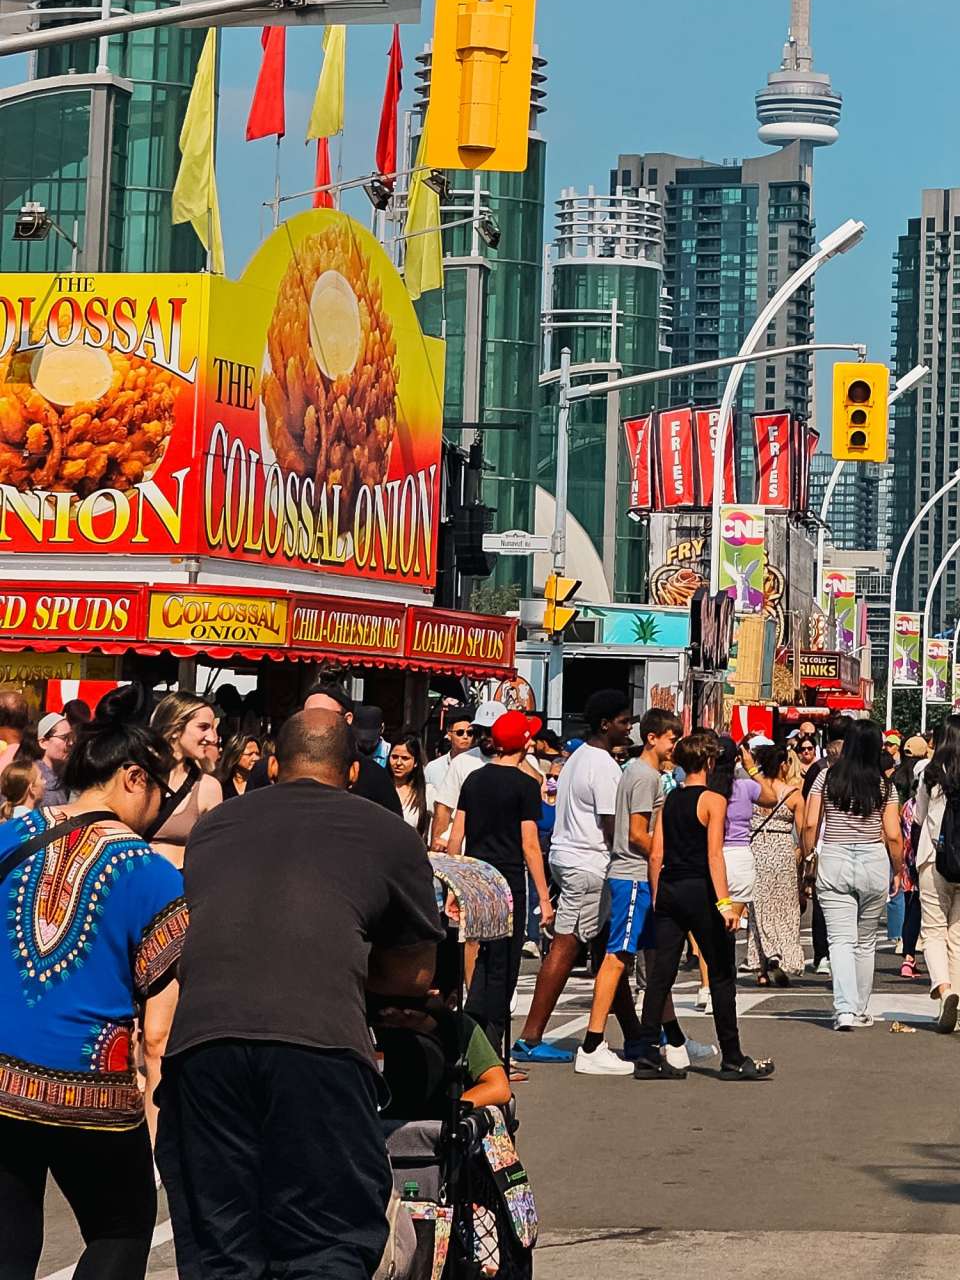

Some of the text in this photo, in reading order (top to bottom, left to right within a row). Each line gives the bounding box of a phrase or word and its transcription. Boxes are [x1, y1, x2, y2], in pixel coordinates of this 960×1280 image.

[54, 277, 95, 293] THE
[213, 357, 257, 411] THE
[671, 420, 684, 495] FRIES
[767, 426, 780, 498] FRIES
[204, 422, 437, 576] COLOSSAL ONION
[720, 519, 765, 538] CNE
[666, 538, 706, 565] FRY
[823, 578, 856, 593] CNE
[32, 595, 131, 633] SPUDS
[162, 594, 281, 636] COLOSSAL
[292, 607, 401, 649] CHILI-CHEESEBURG
[896, 620, 920, 632] CNE
[190, 624, 261, 641] ONION
[412, 620, 505, 660] LOADED SPUDS
[928, 645, 949, 657] CNE
[800, 663, 837, 677] RINKS
